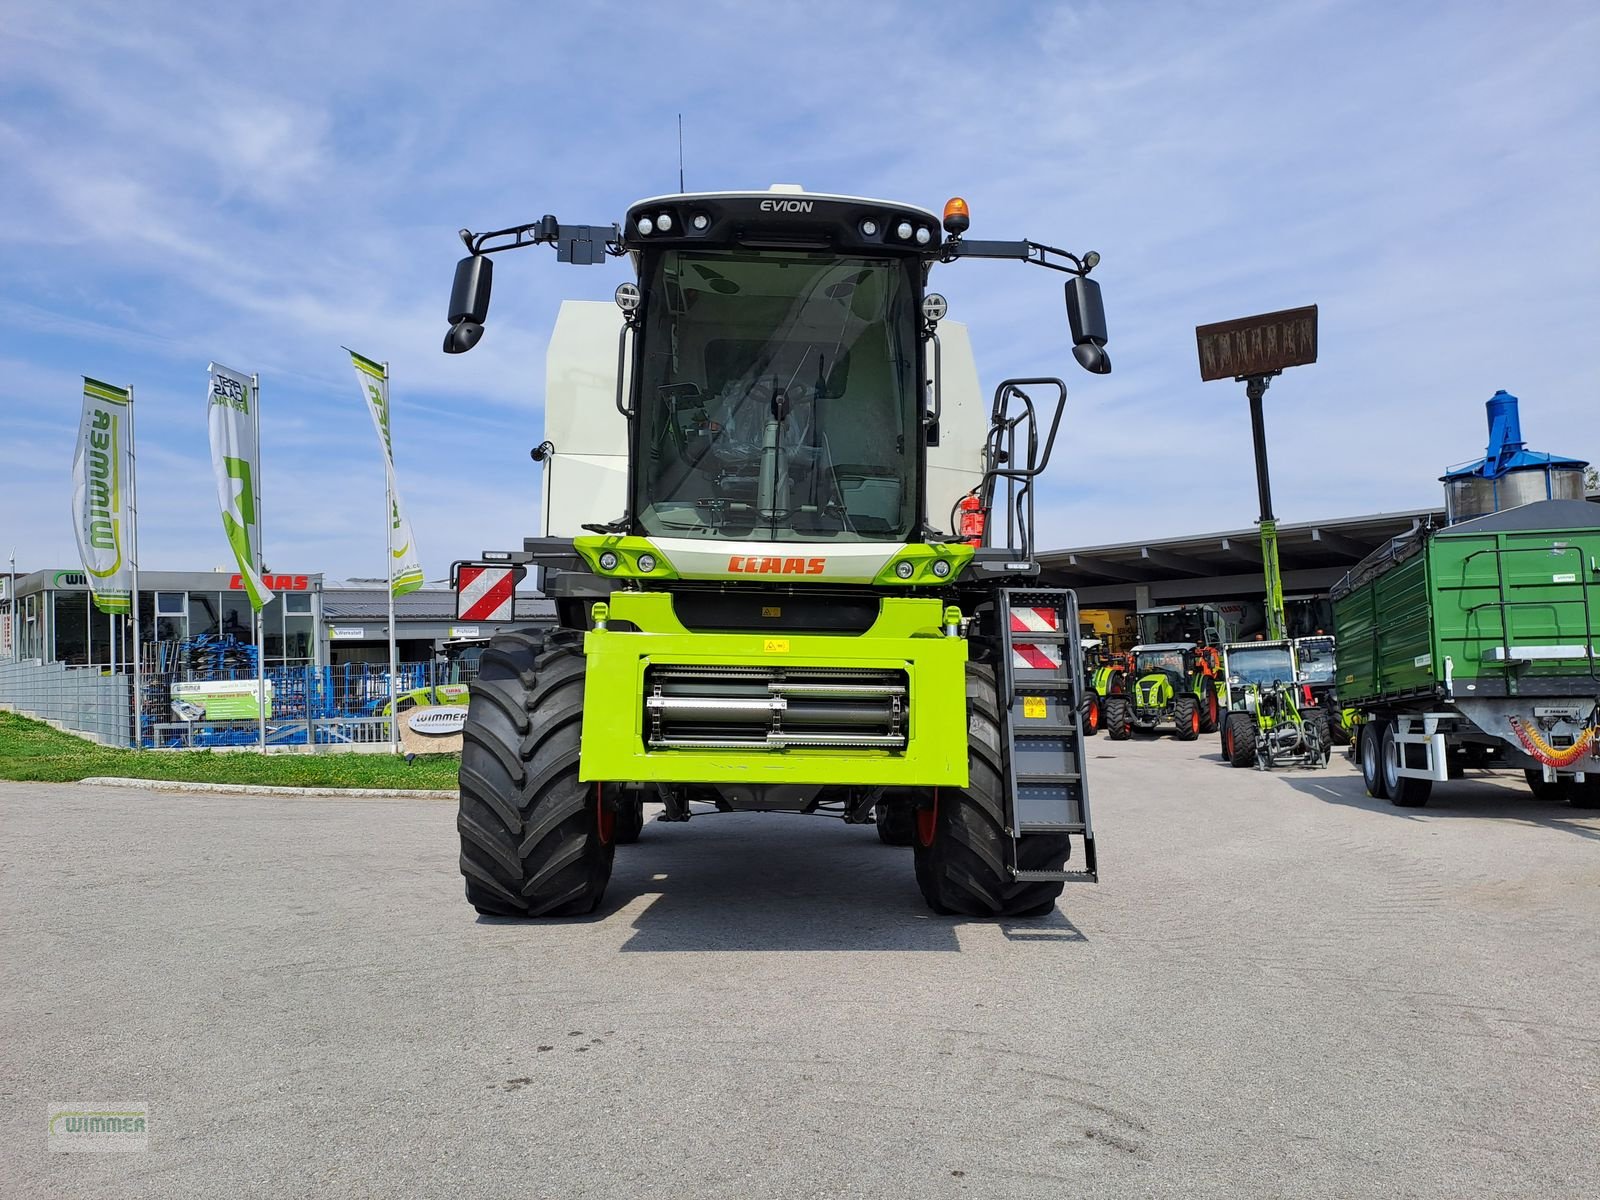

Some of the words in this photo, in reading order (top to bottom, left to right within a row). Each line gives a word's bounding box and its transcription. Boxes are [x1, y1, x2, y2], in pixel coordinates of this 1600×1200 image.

[760, 200, 813, 212] EVION
[727, 556, 826, 574] CLAAS
[229, 574, 308, 590] CAAS
